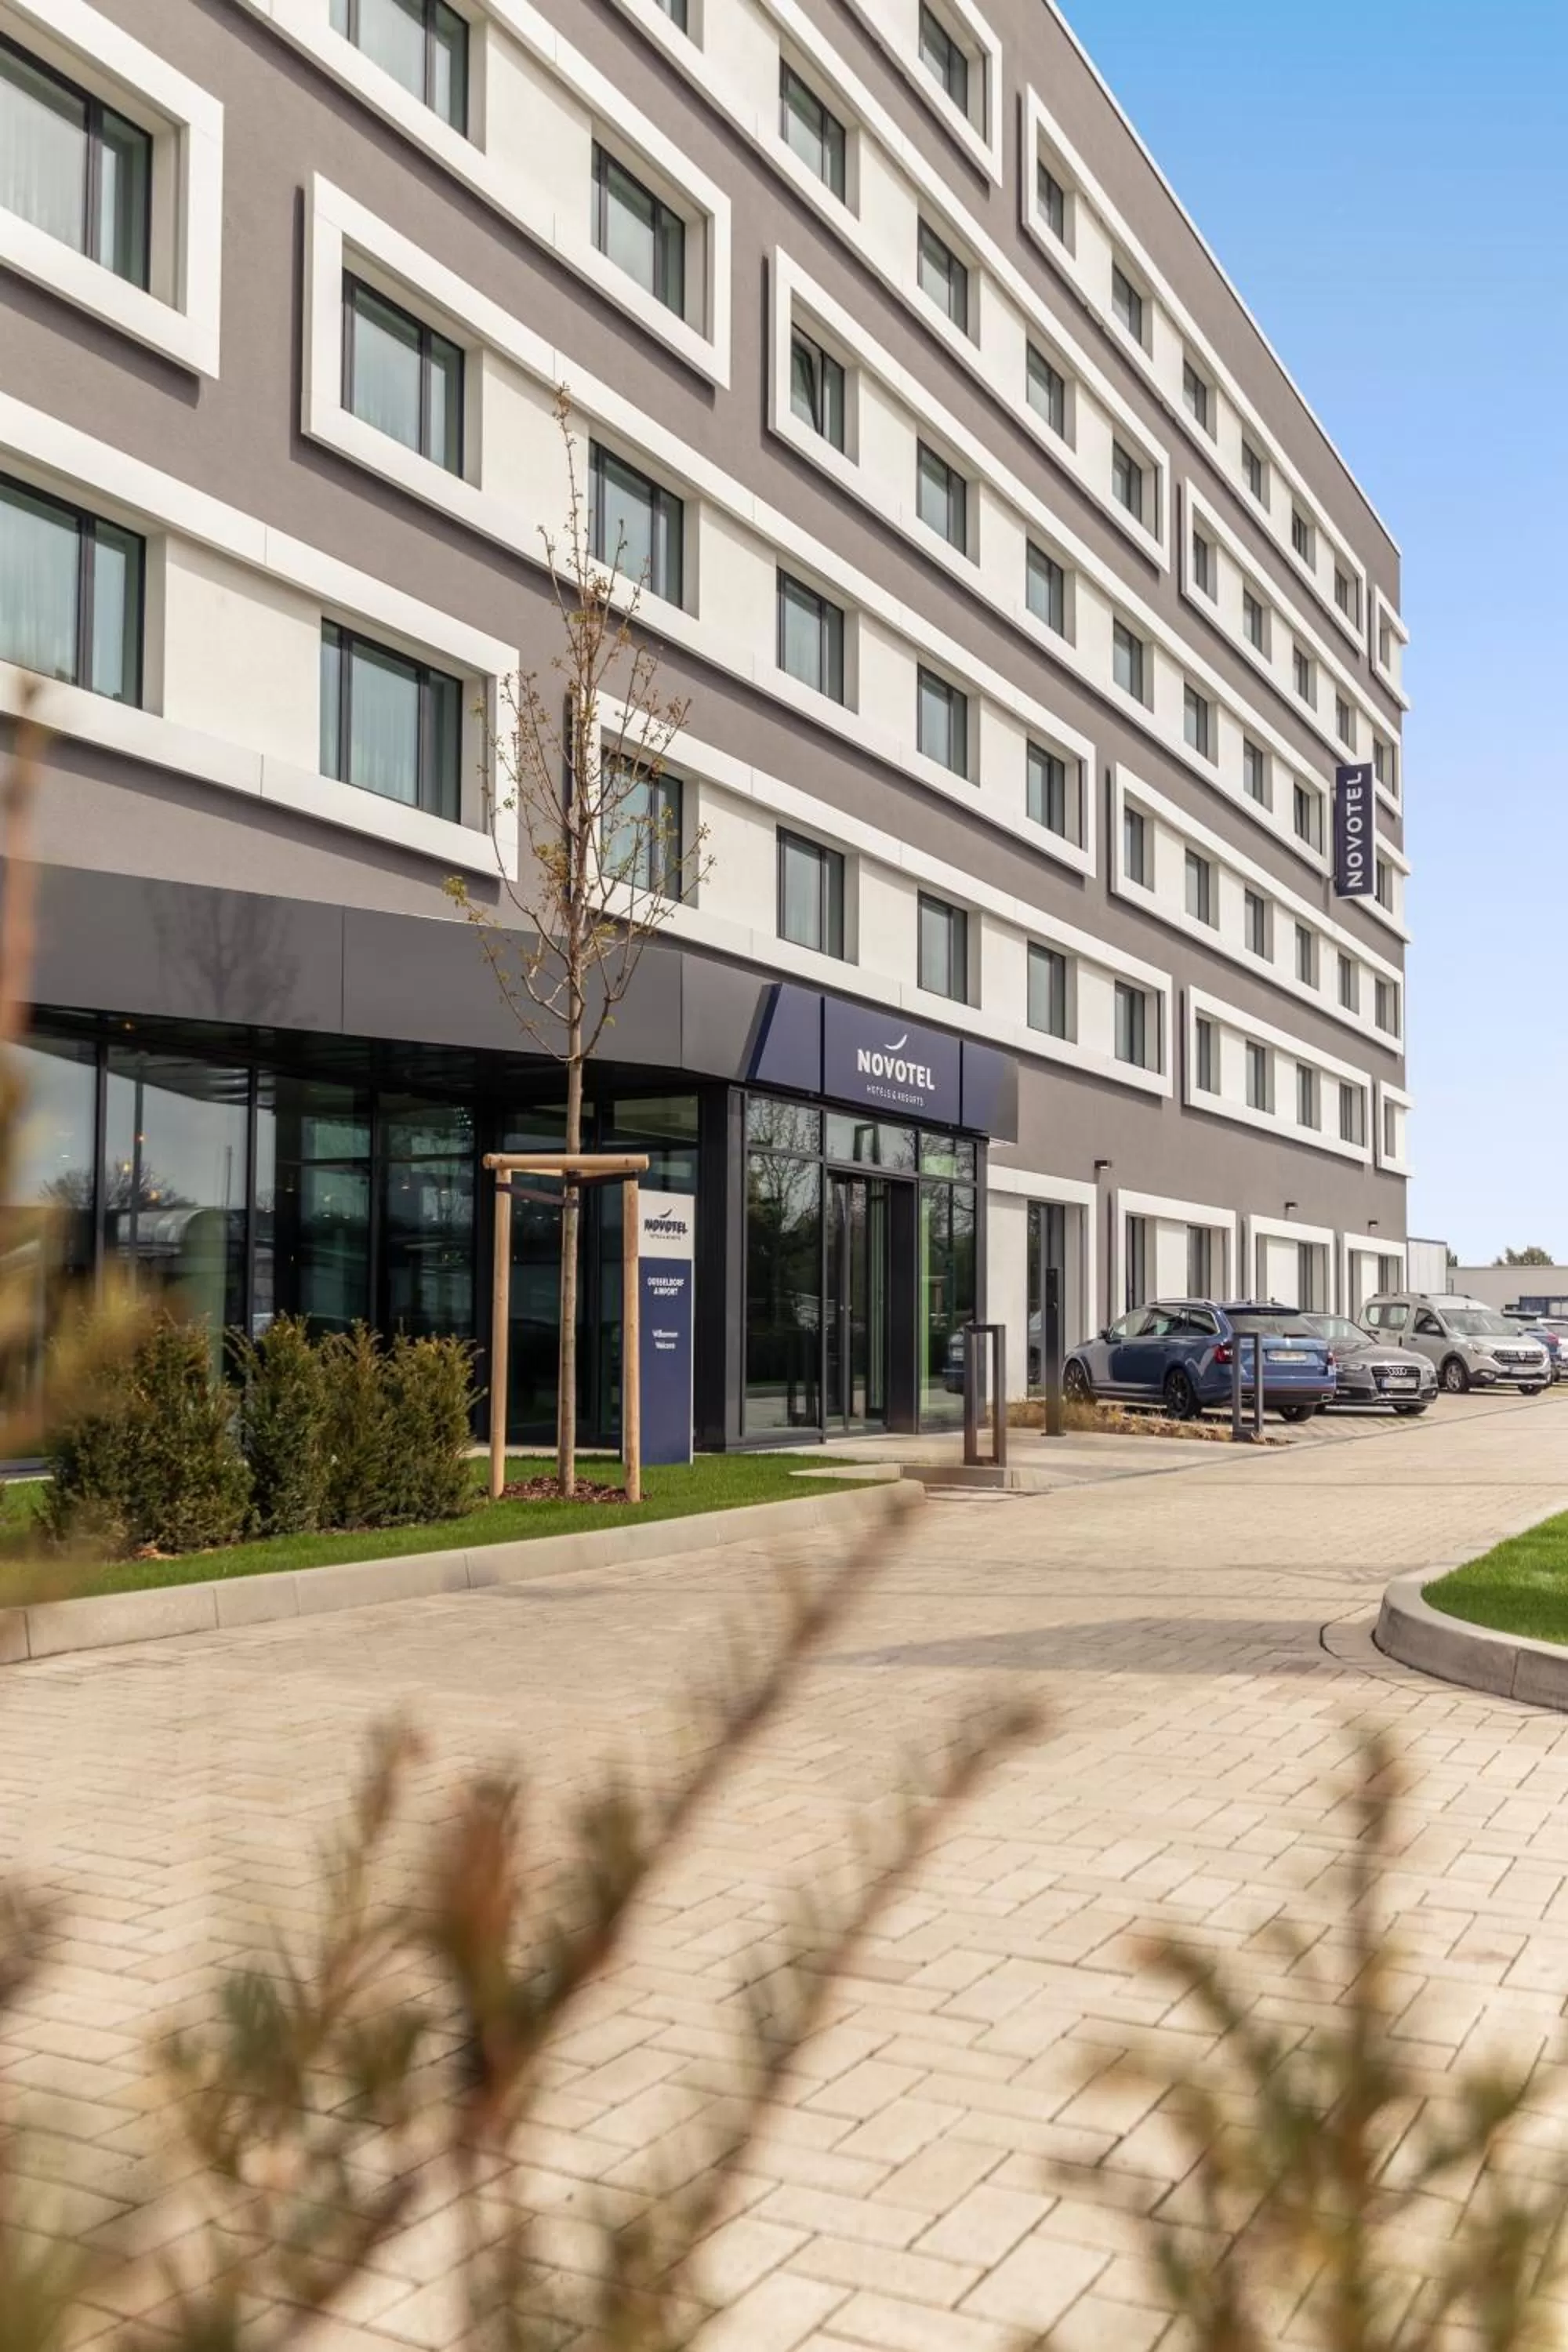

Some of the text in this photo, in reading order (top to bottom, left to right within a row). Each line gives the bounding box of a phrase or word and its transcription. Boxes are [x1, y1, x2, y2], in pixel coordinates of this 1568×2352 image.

[1346, 771, 1363, 888] NOVOTEL
[857, 1048, 935, 1091] NOVOTEL
[866, 1084, 891, 1098] HOTELS
[644, 1218, 688, 1234] NOVOTEL
